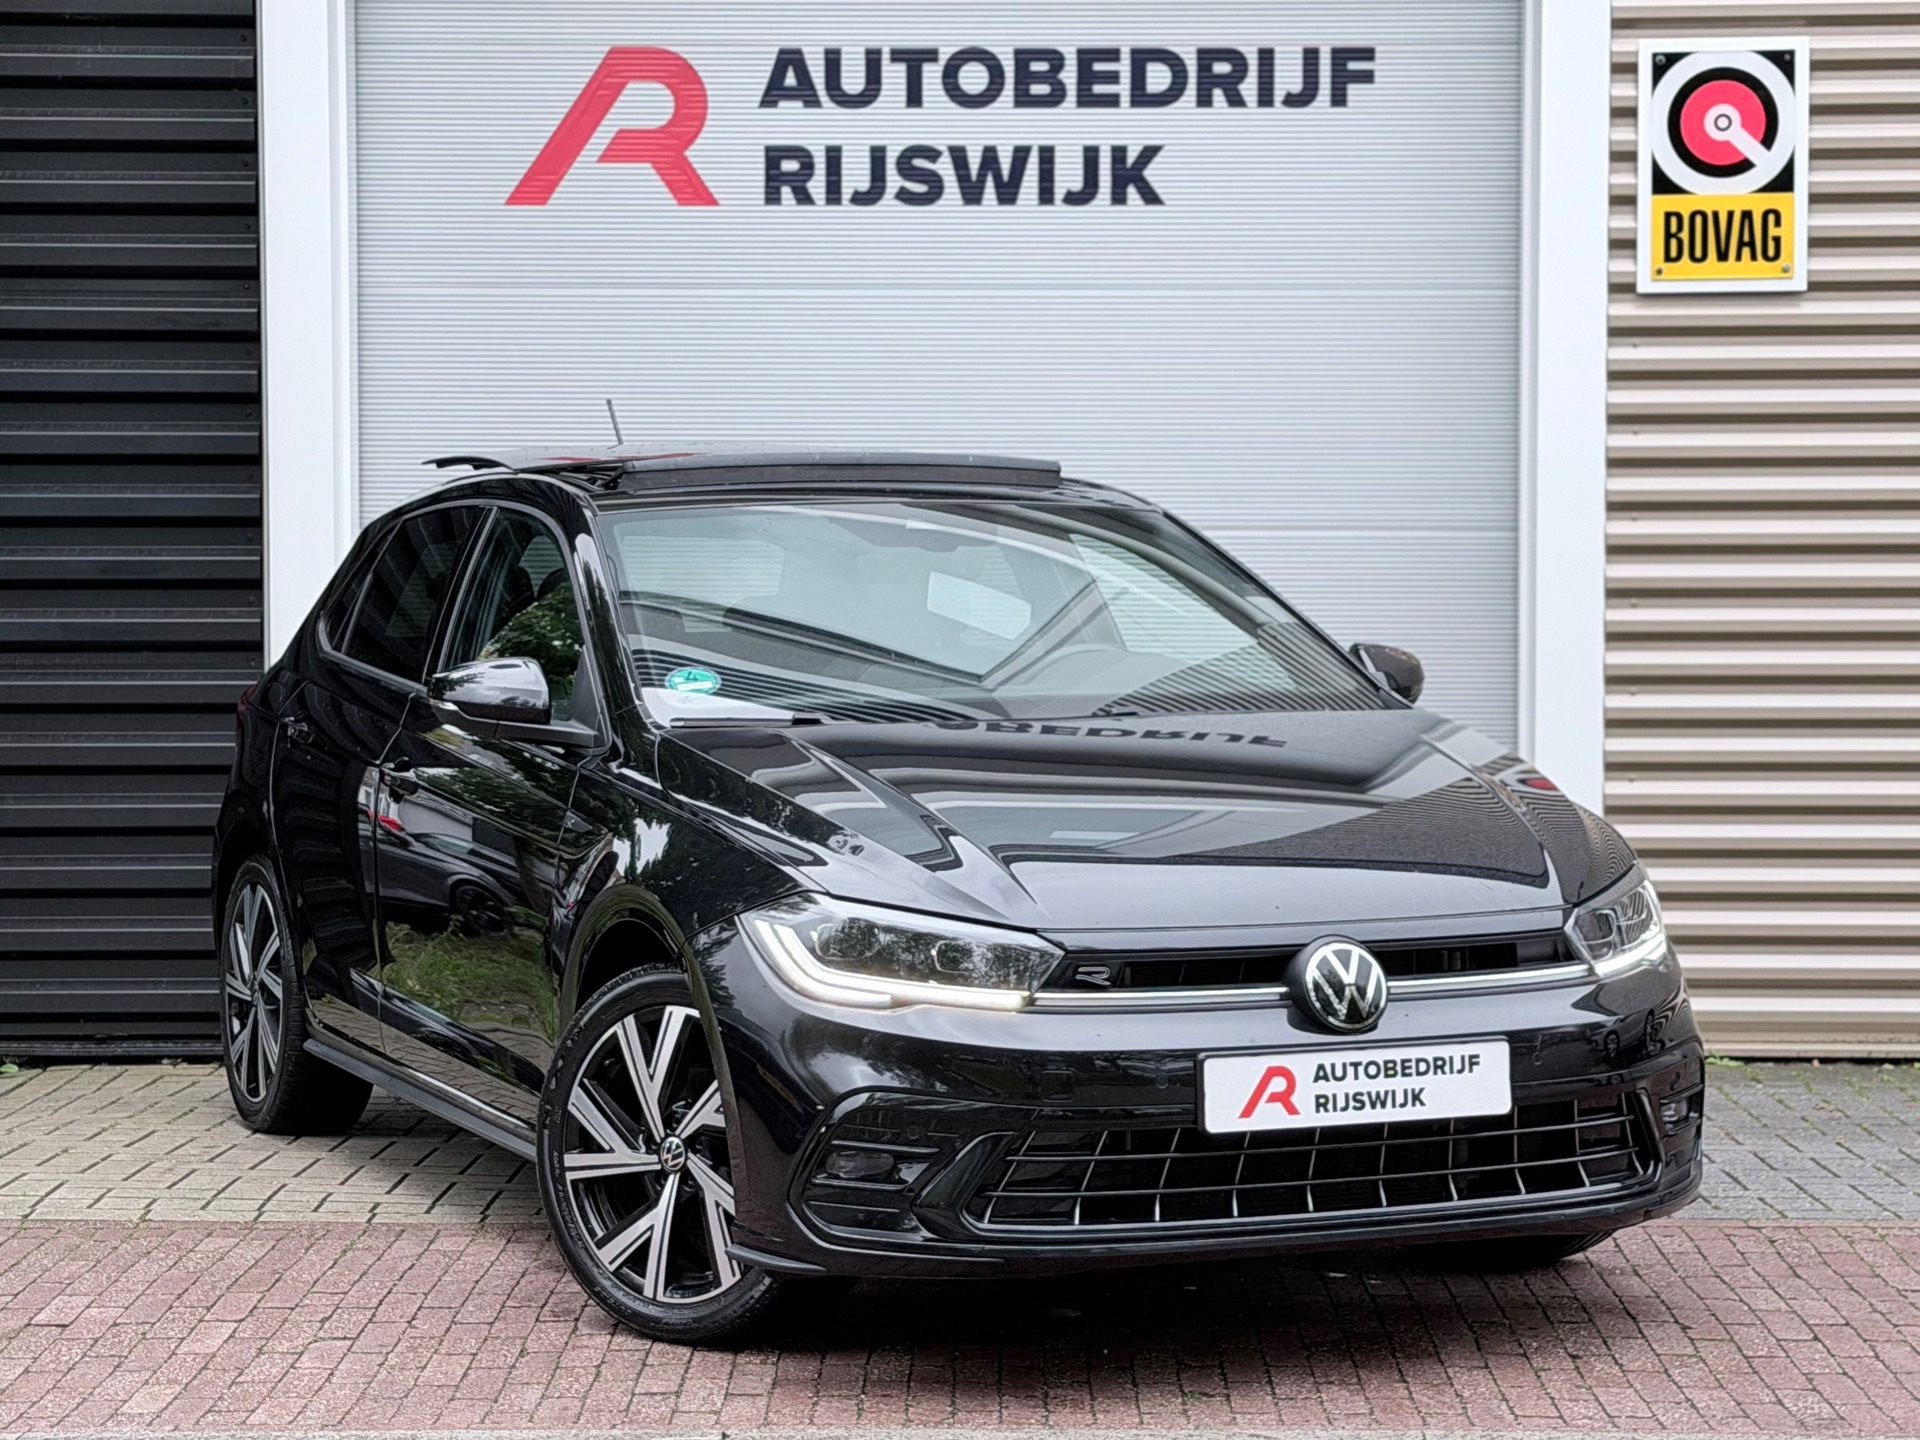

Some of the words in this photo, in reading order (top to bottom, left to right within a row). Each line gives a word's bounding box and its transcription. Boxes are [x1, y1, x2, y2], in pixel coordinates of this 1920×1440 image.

[759, 46, 1376, 109] AUTOBEDRIJF
[764, 144, 1164, 207] RIJSWIJK
[1663, 208, 1782, 264] BOVAG
[1312, 1054, 1481, 1083] AUTOBEDRIJF
[1314, 1087, 1427, 1114] RIJSWIJK
